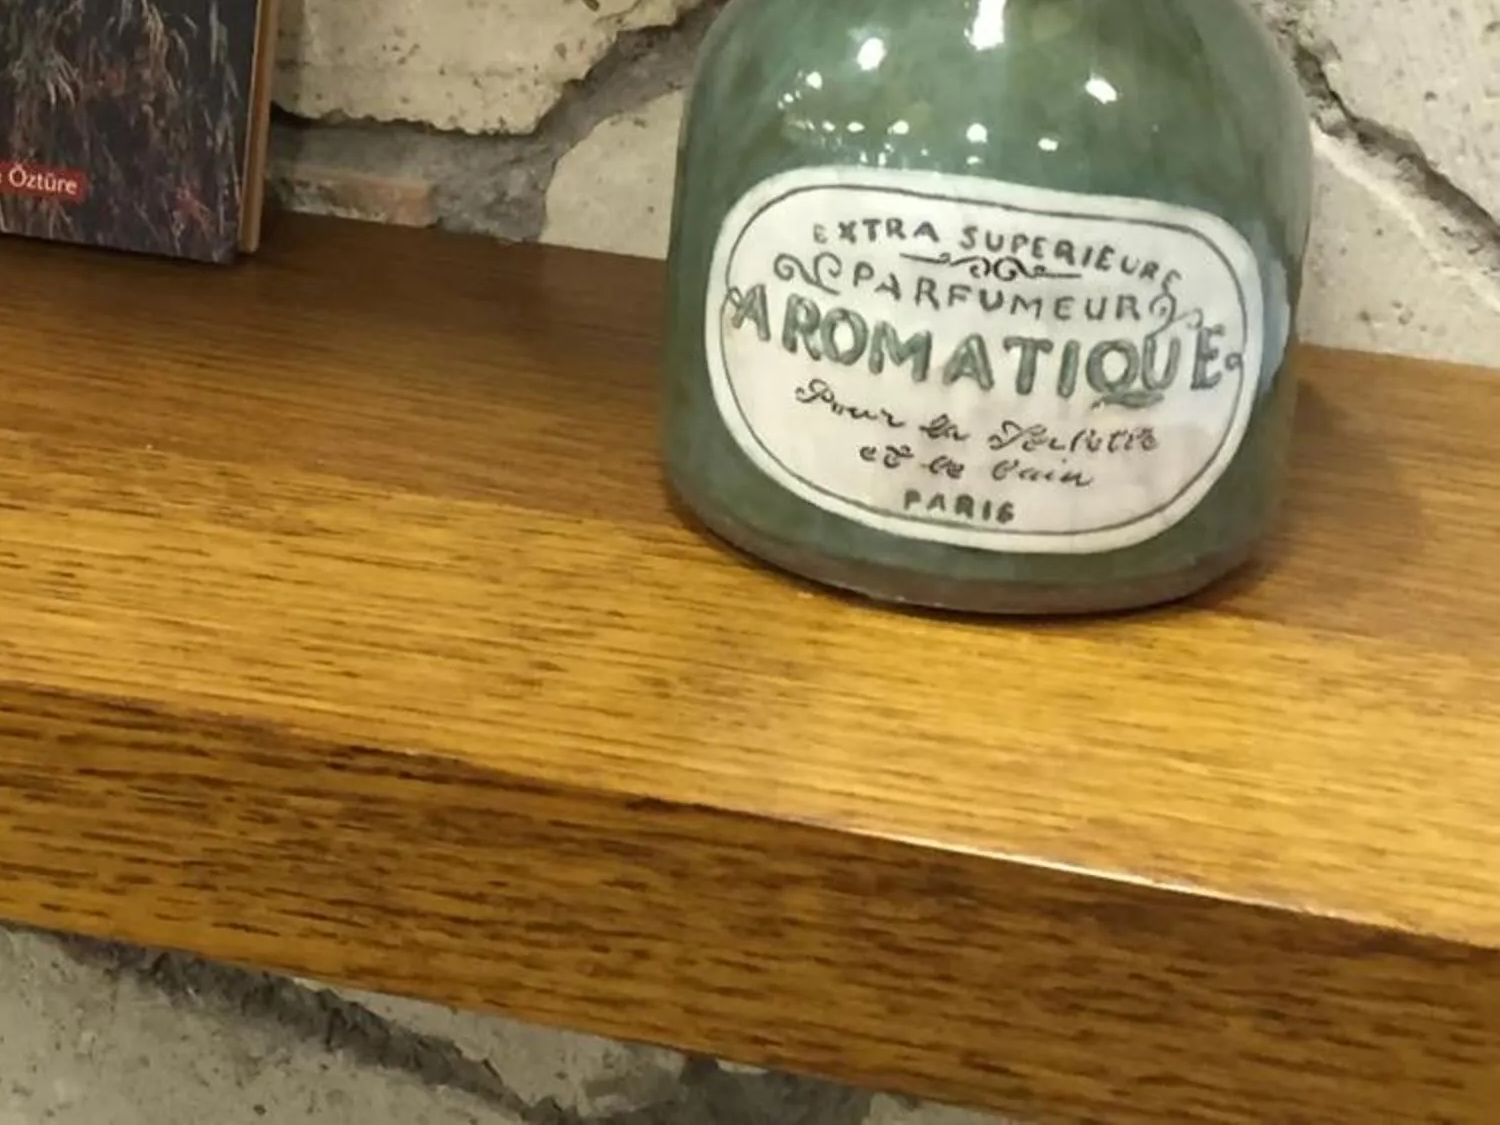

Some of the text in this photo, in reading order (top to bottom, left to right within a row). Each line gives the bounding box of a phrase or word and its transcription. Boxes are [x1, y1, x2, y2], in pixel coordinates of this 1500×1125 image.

[8, 162, 80, 196] Öztüre
[813, 218, 1183, 289] EXTRA SUPERIEURE
[853, 261, 1142, 322] PARFUMEUR
[724, 283, 1226, 410] AROMATIQUE
[904, 489, 1015, 525] PARIS
